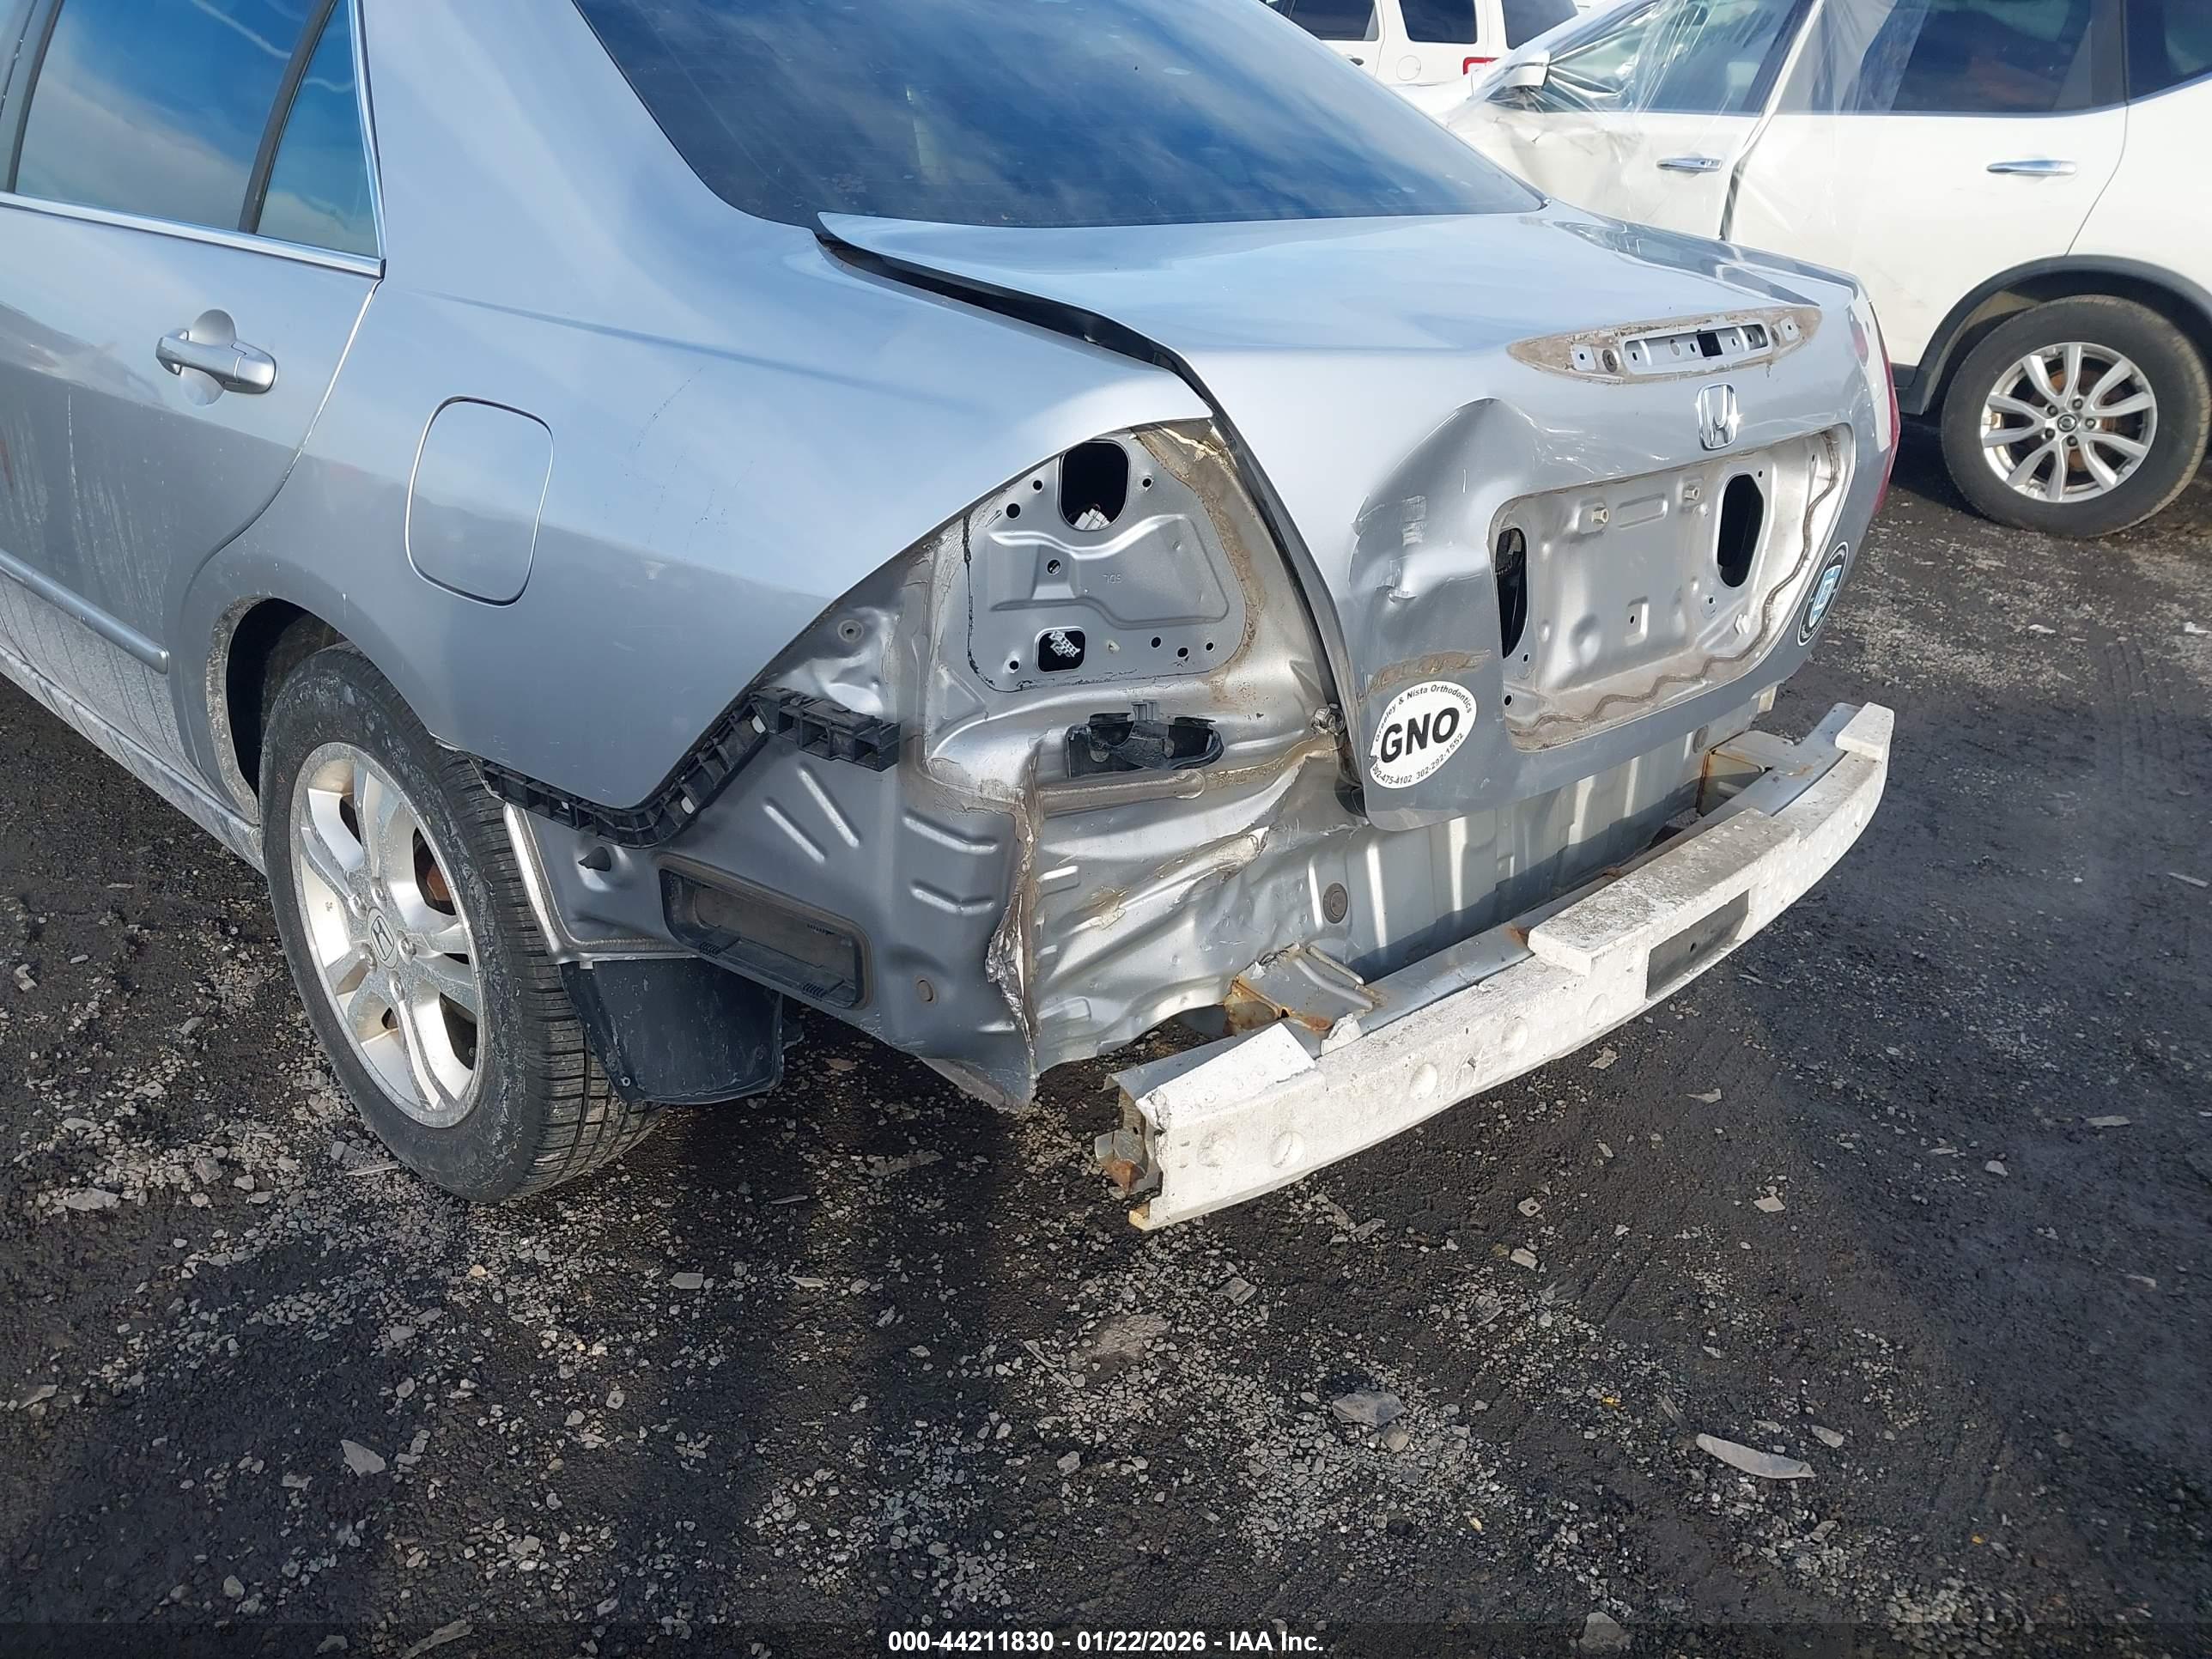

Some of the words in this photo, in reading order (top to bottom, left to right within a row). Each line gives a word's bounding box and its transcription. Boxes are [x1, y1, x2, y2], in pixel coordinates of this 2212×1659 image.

[1398, 696, 1405, 706] &
[1407, 686, 1428, 700] Nista
[1430, 684, 1473, 714] Orthodontics
[1372, 763, 1413, 785] 302-475-4102
[1416, 732, 1464, 780] 302-292-1552
[1380, 707, 1460, 763] GNO
